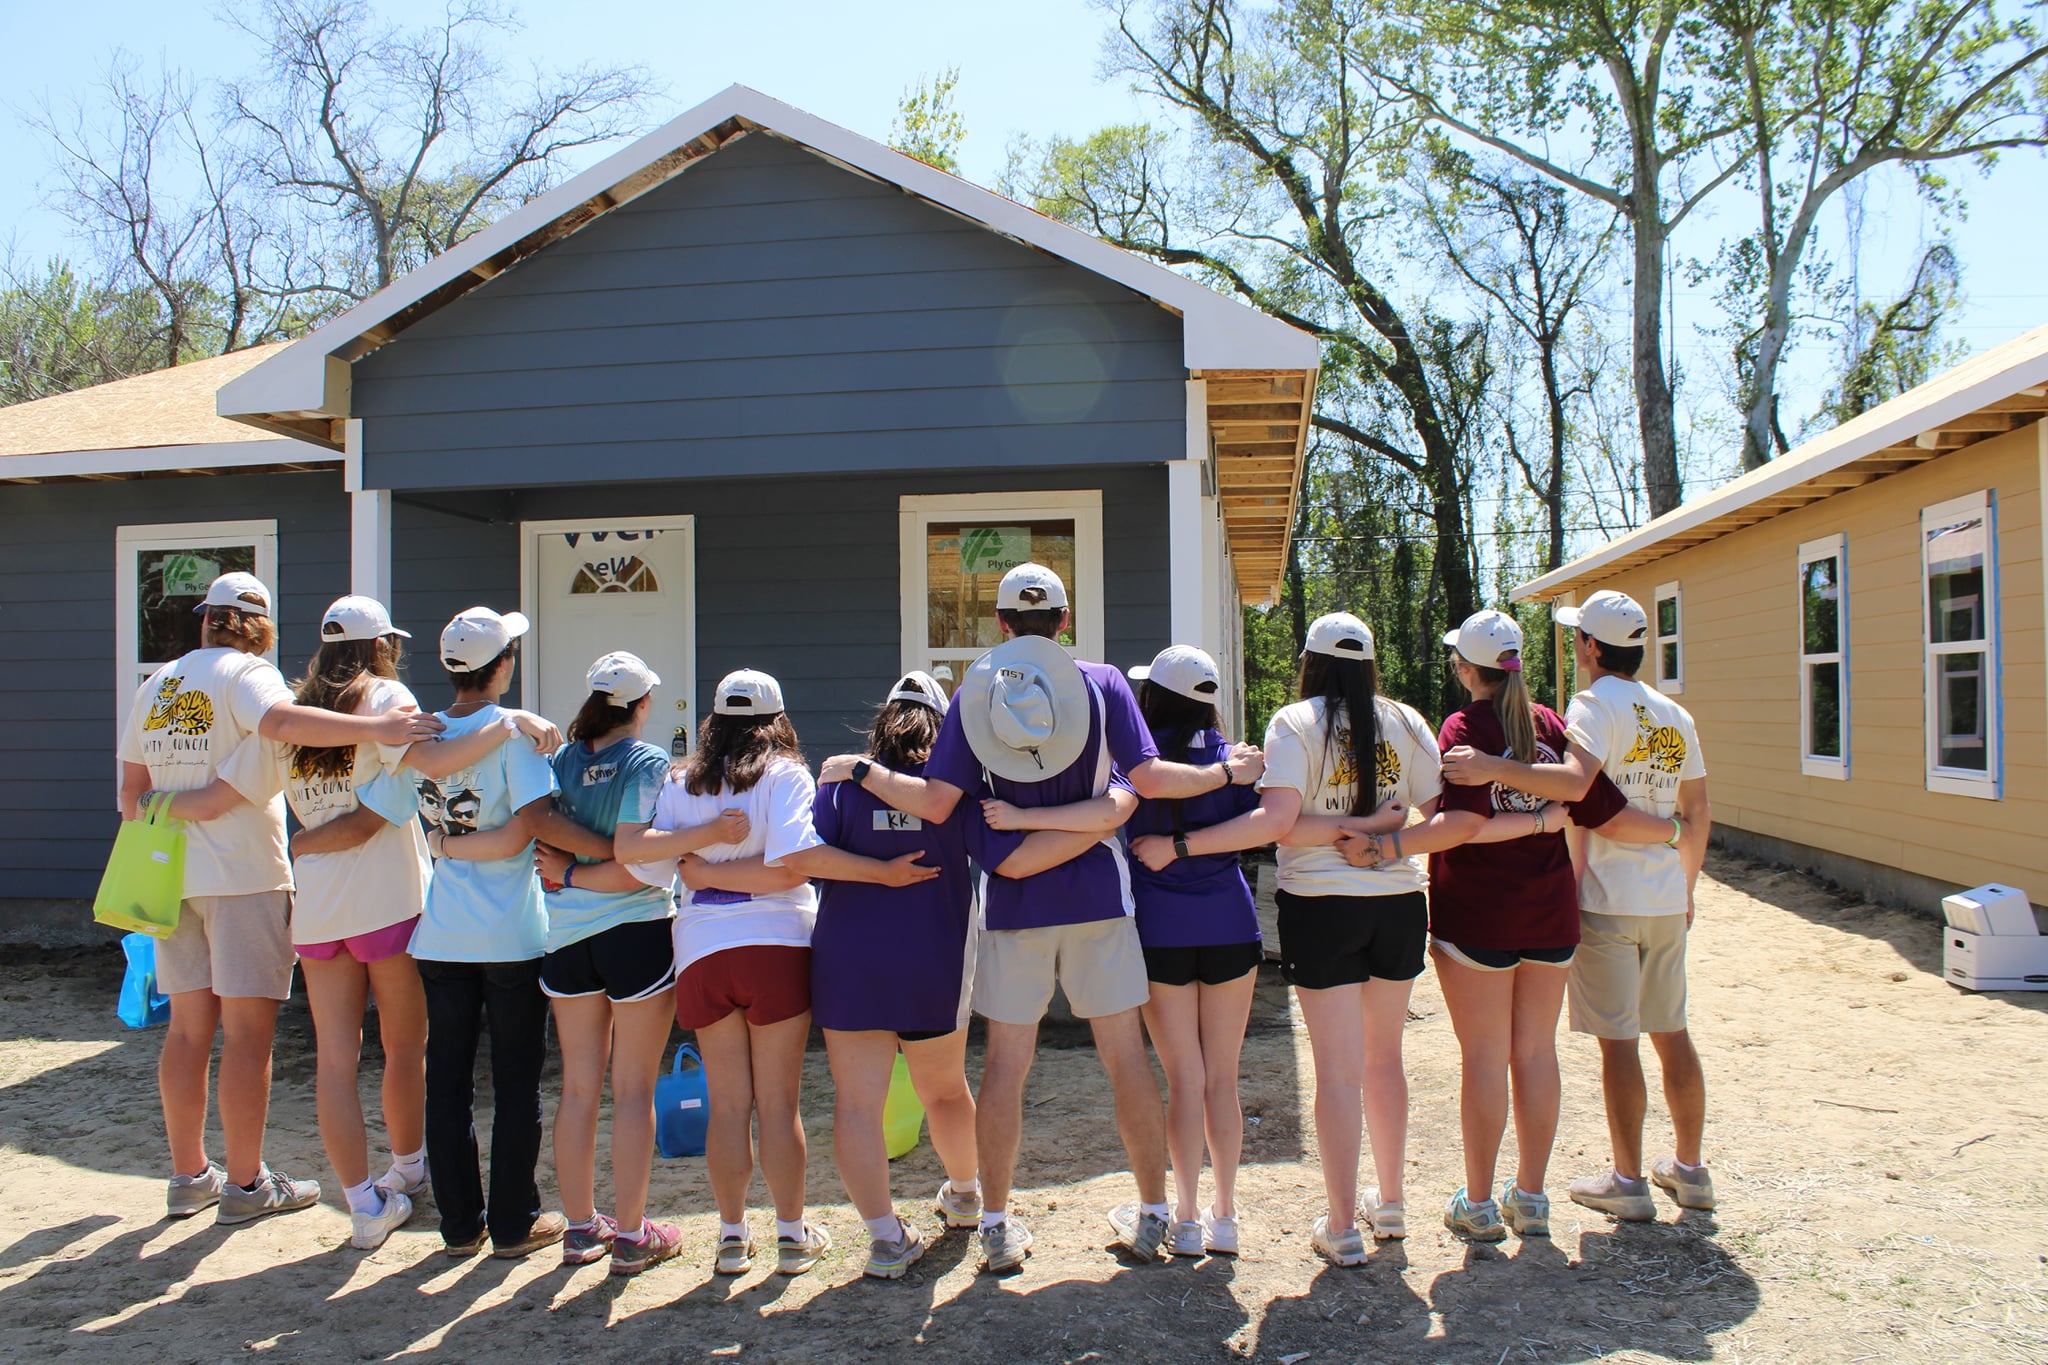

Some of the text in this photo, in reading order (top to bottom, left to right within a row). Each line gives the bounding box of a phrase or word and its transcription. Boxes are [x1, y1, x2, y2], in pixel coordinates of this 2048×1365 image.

[988, 560, 1003, 571] Ply
[185, 583, 198, 593] Ply
[1001, 669, 1024, 680] LSU
[887, 812, 910, 828] KK
